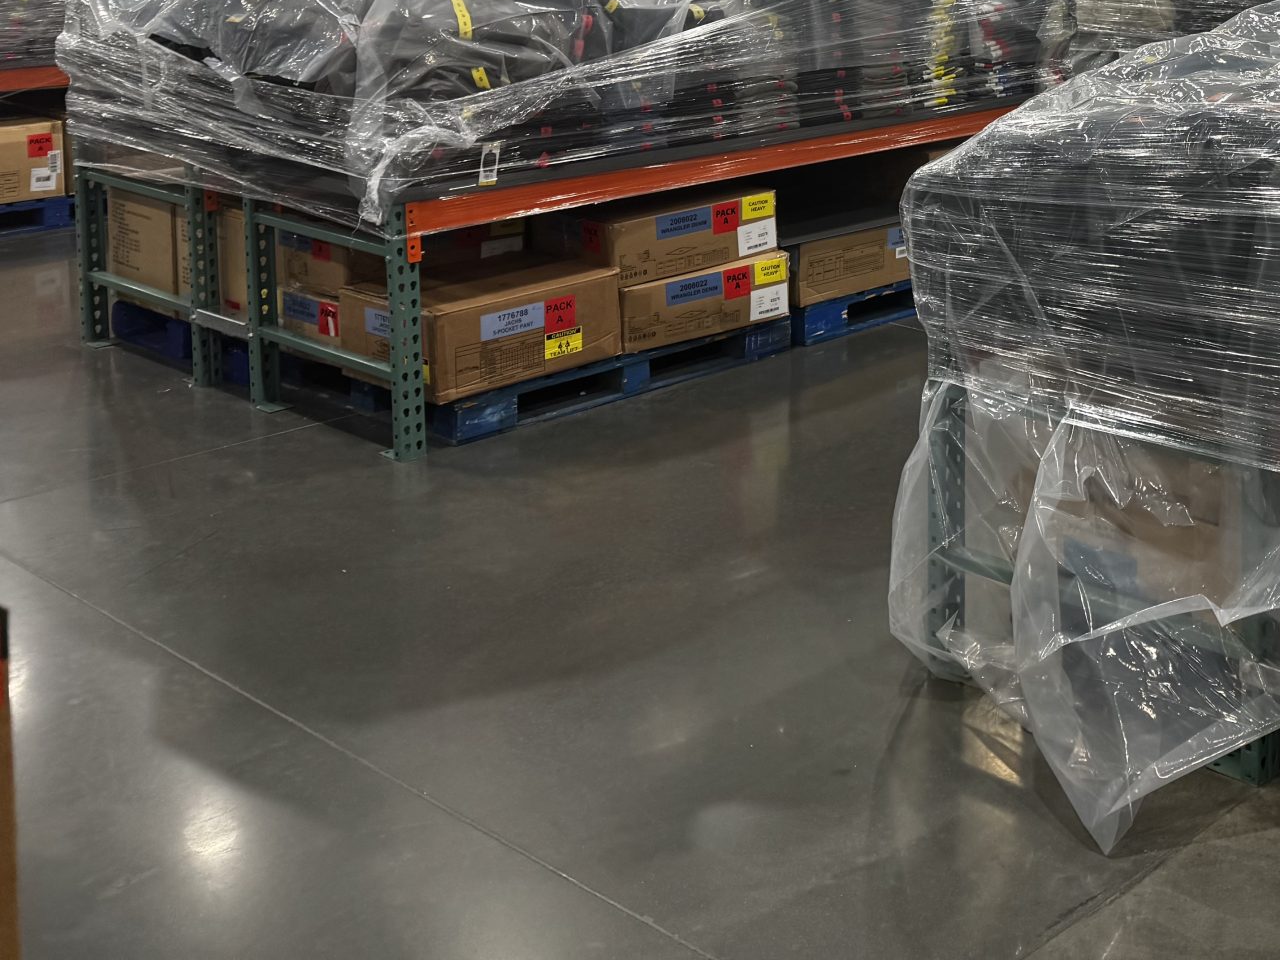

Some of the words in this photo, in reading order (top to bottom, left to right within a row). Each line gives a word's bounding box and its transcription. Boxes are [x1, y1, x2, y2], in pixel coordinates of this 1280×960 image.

[29, 137, 52, 145] PACK
[748, 199, 769, 207] CAUTION
[715, 207, 736, 218] PACK
[750, 205, 766, 213] HEAVY
[726, 271, 748, 283] PACK
[546, 300, 573, 315] PACK
[497, 308, 529, 322] 1776788
[556, 315, 564, 324] A
